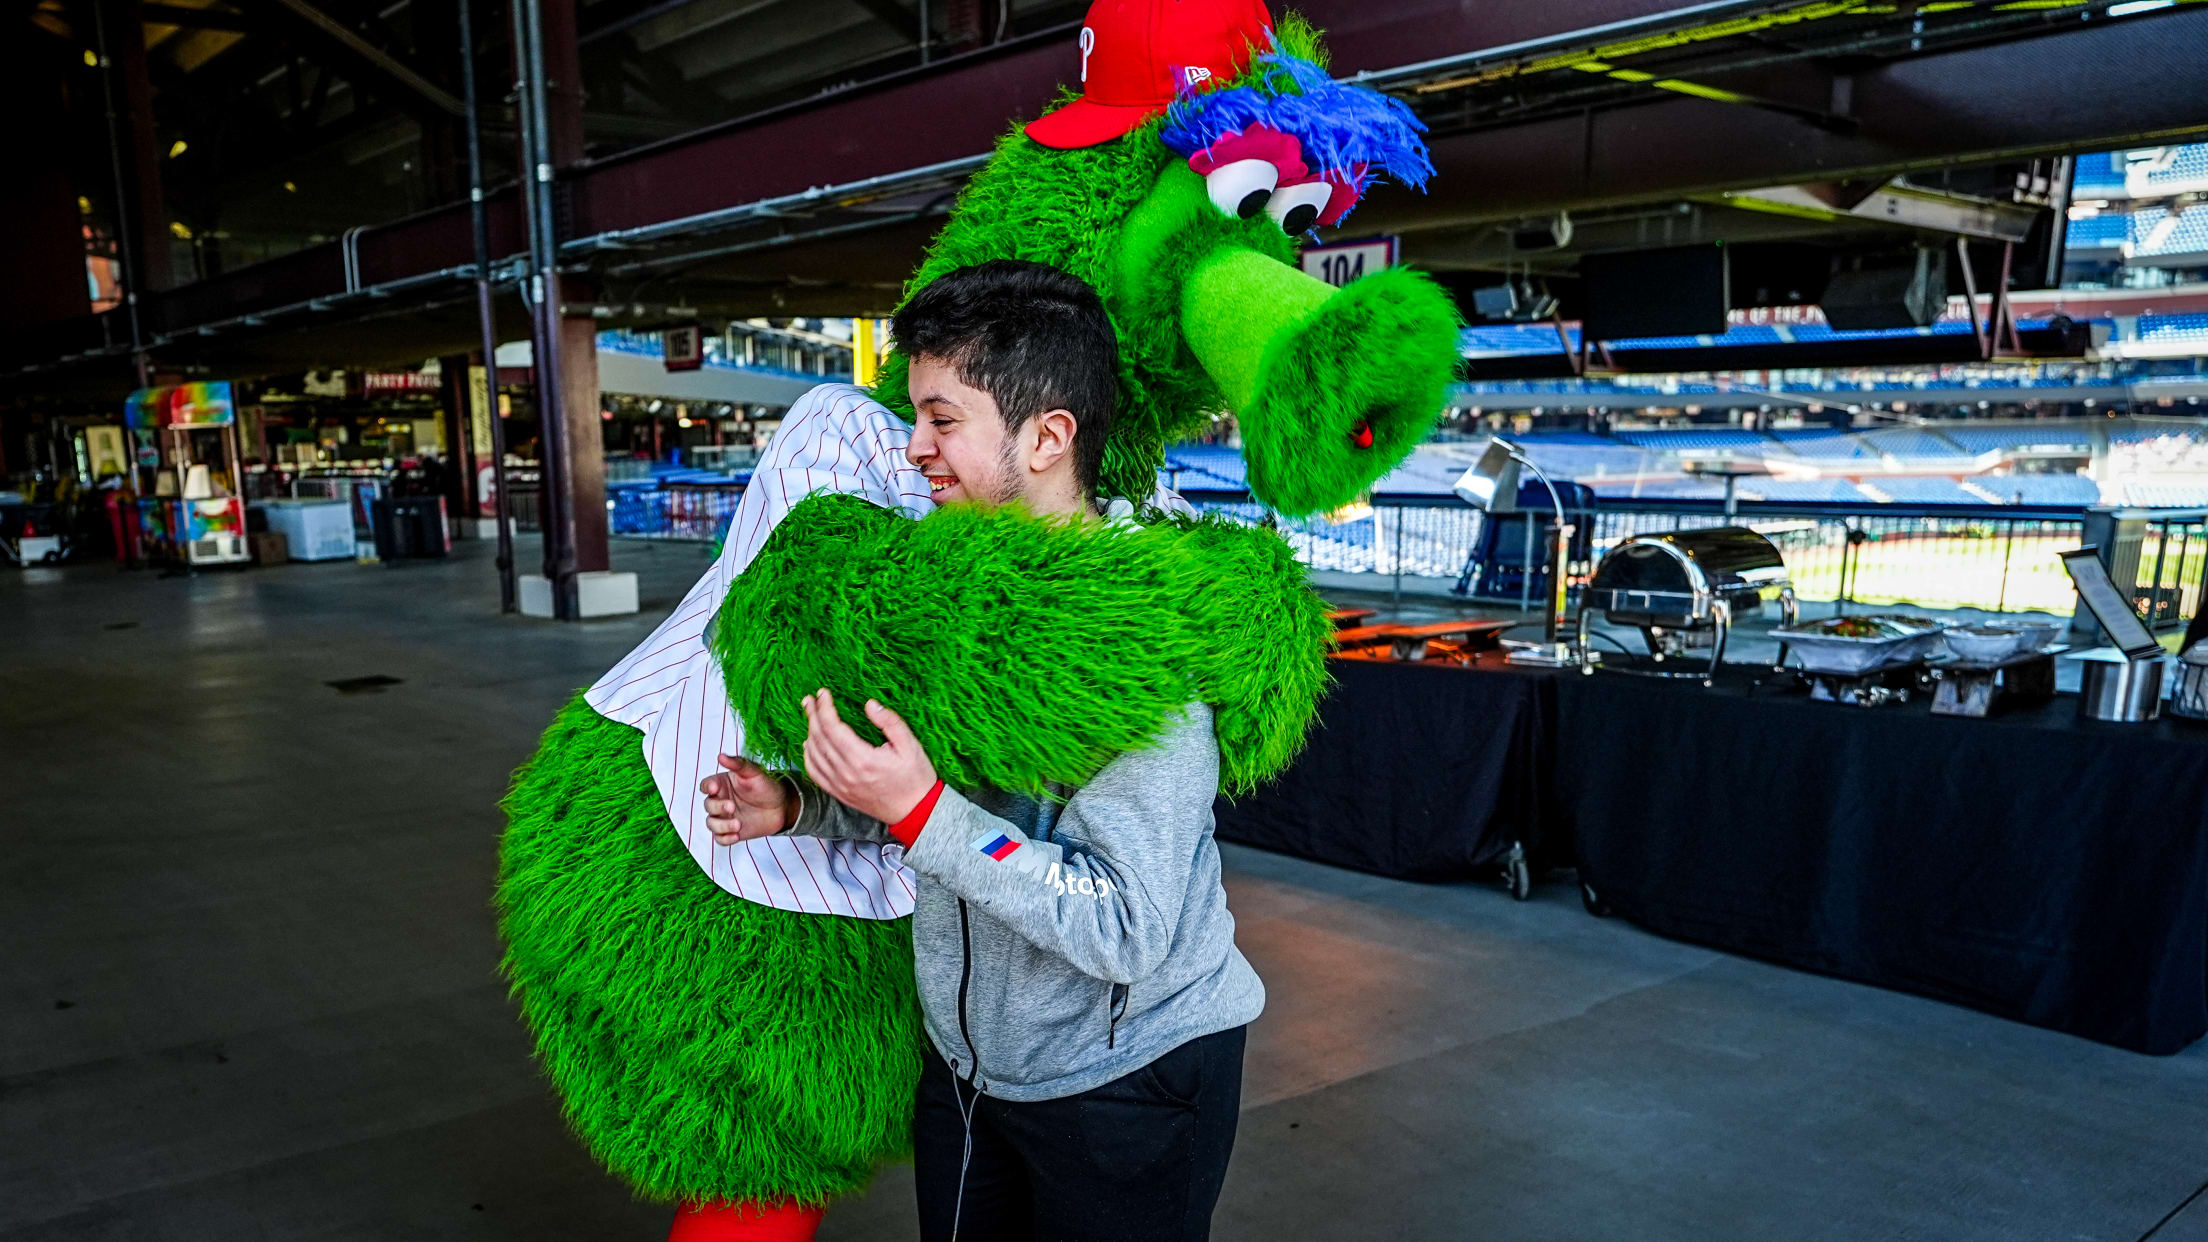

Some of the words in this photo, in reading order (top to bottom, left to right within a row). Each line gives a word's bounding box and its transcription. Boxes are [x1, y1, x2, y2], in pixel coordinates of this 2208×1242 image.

[1079, 27, 1094, 82] P
[1749, 307, 1768, 325] OF
[1774, 305, 1801, 324] THE
